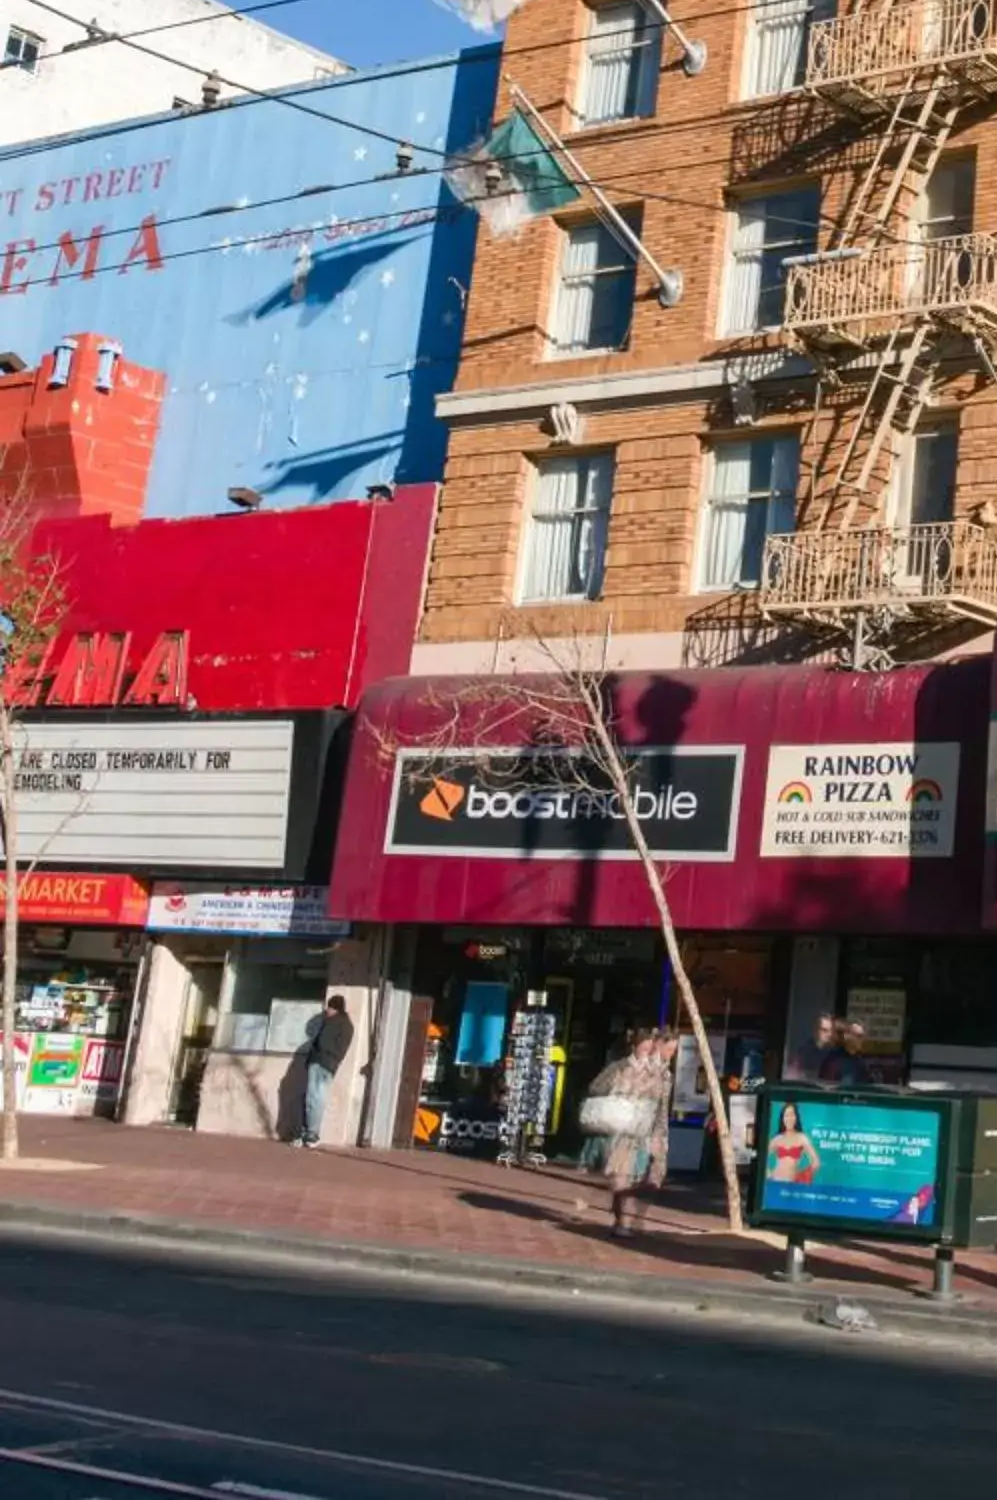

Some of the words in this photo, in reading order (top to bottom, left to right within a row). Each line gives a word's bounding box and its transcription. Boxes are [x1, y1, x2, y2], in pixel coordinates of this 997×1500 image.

[34, 159, 172, 212] STREET
[19, 752, 43, 769] ARE
[51, 752, 97, 770] CLOSED
[106, 751, 197, 769] TEMPORARILY
[205, 751, 231, 769] FOR
[804, 753, 920, 778] RAINBOW
[13, 773, 82, 790] EMODELING
[823, 782, 893, 803] PIZZA
[776, 811, 800, 823] HOT
[801, 811, 810, 822] &
[812, 810, 843, 823] COLD
[775, 831, 806, 845] FREE
[18, 877, 107, 904] MARKET
